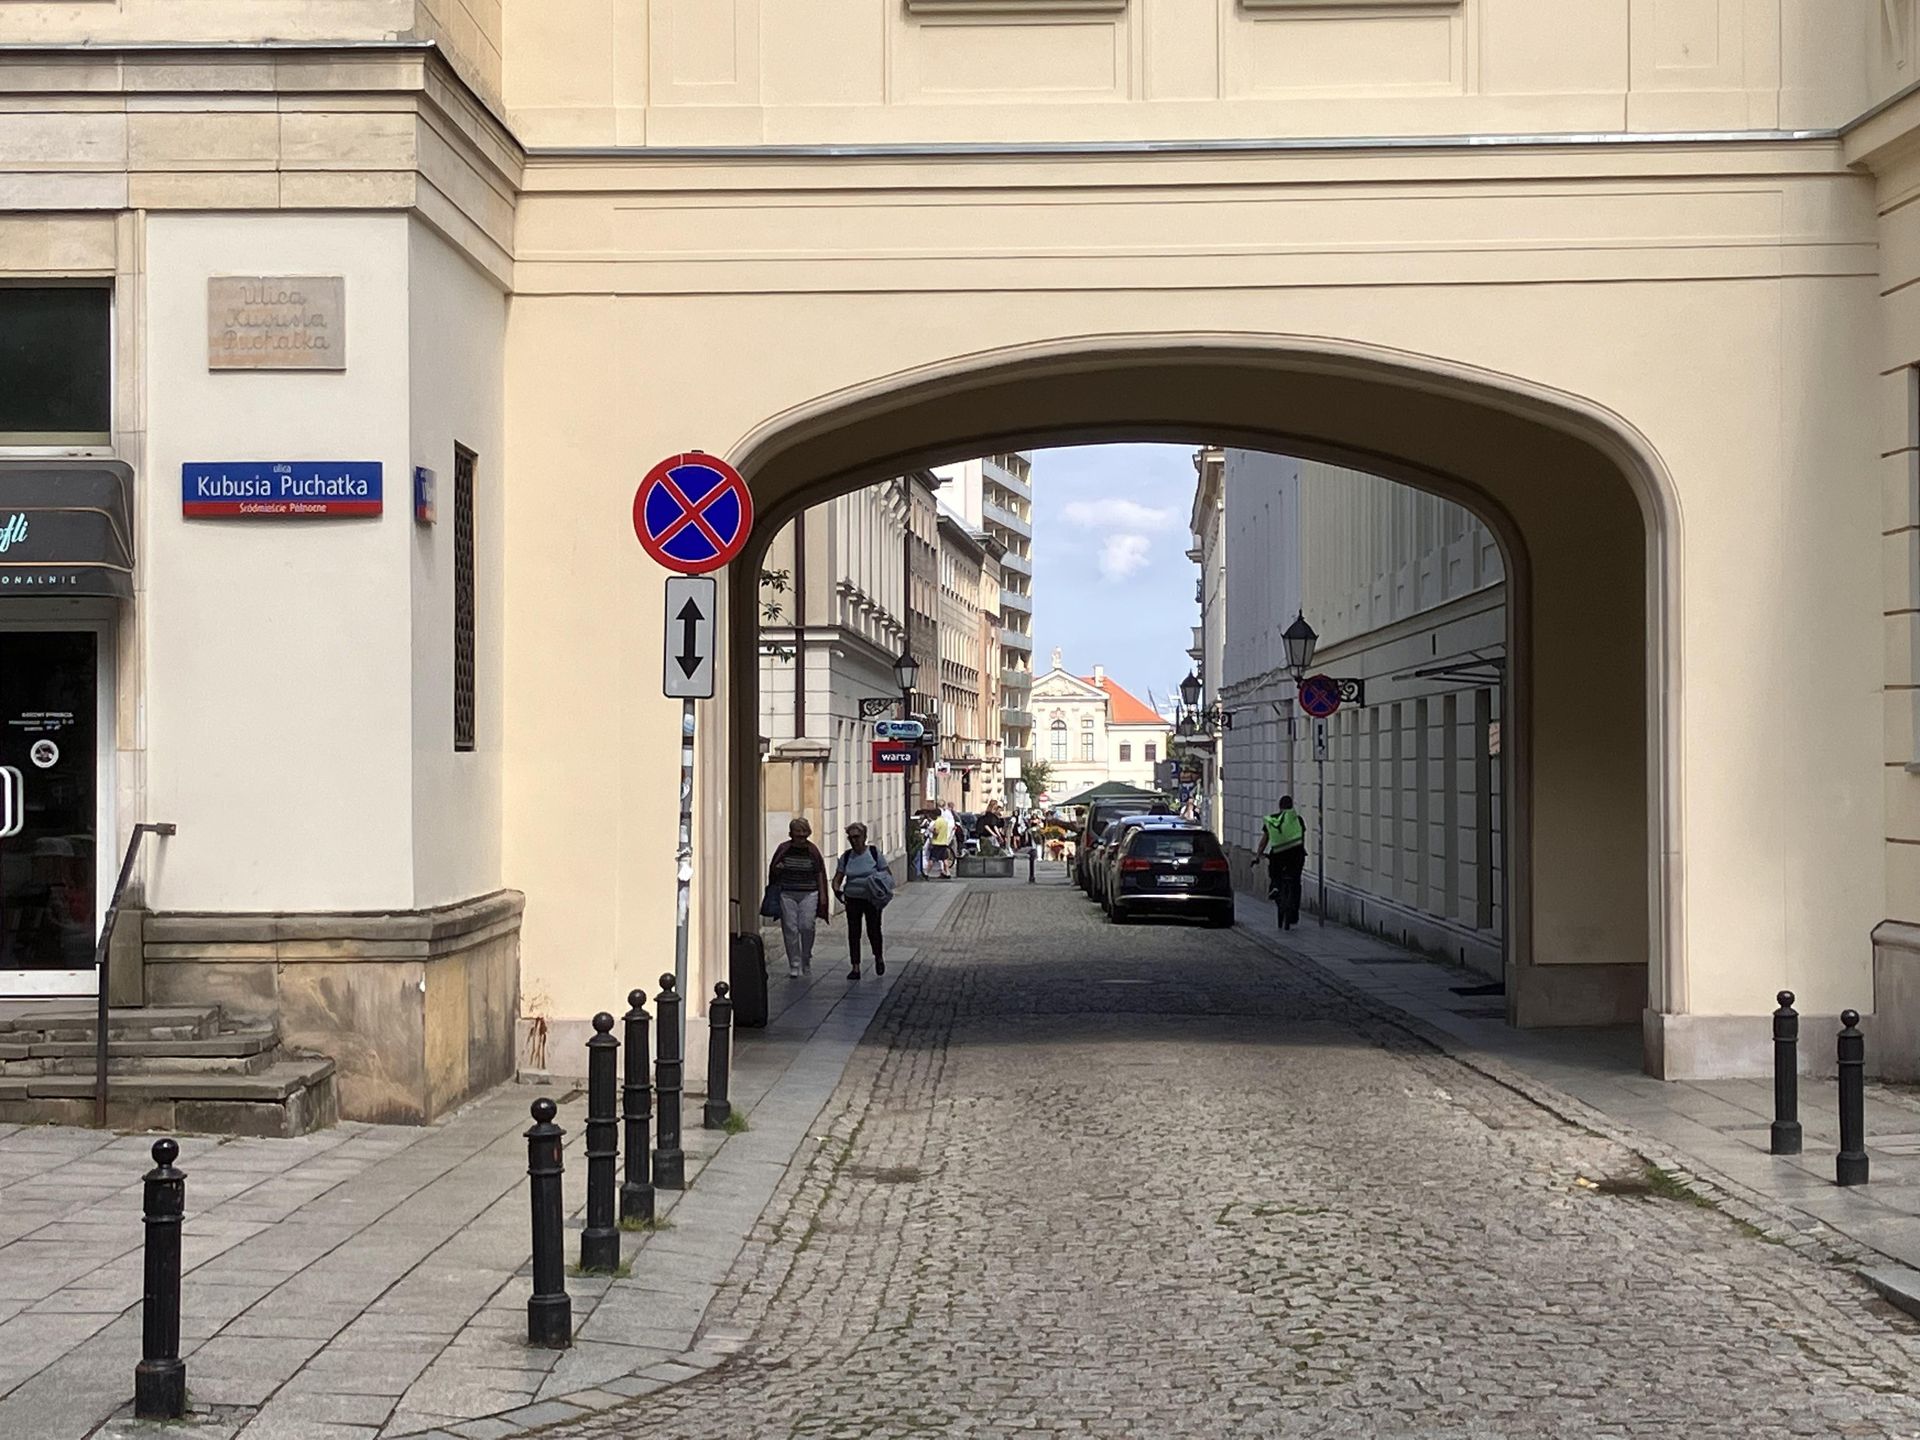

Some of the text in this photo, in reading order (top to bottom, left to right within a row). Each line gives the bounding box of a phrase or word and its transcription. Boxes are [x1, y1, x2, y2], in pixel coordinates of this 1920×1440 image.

[239, 286, 307, 306] Ulica
[273, 463, 292, 474] ulica
[197, 474, 369, 497] Kubusia Puchatka
[881, 753, 912, 761] warta
